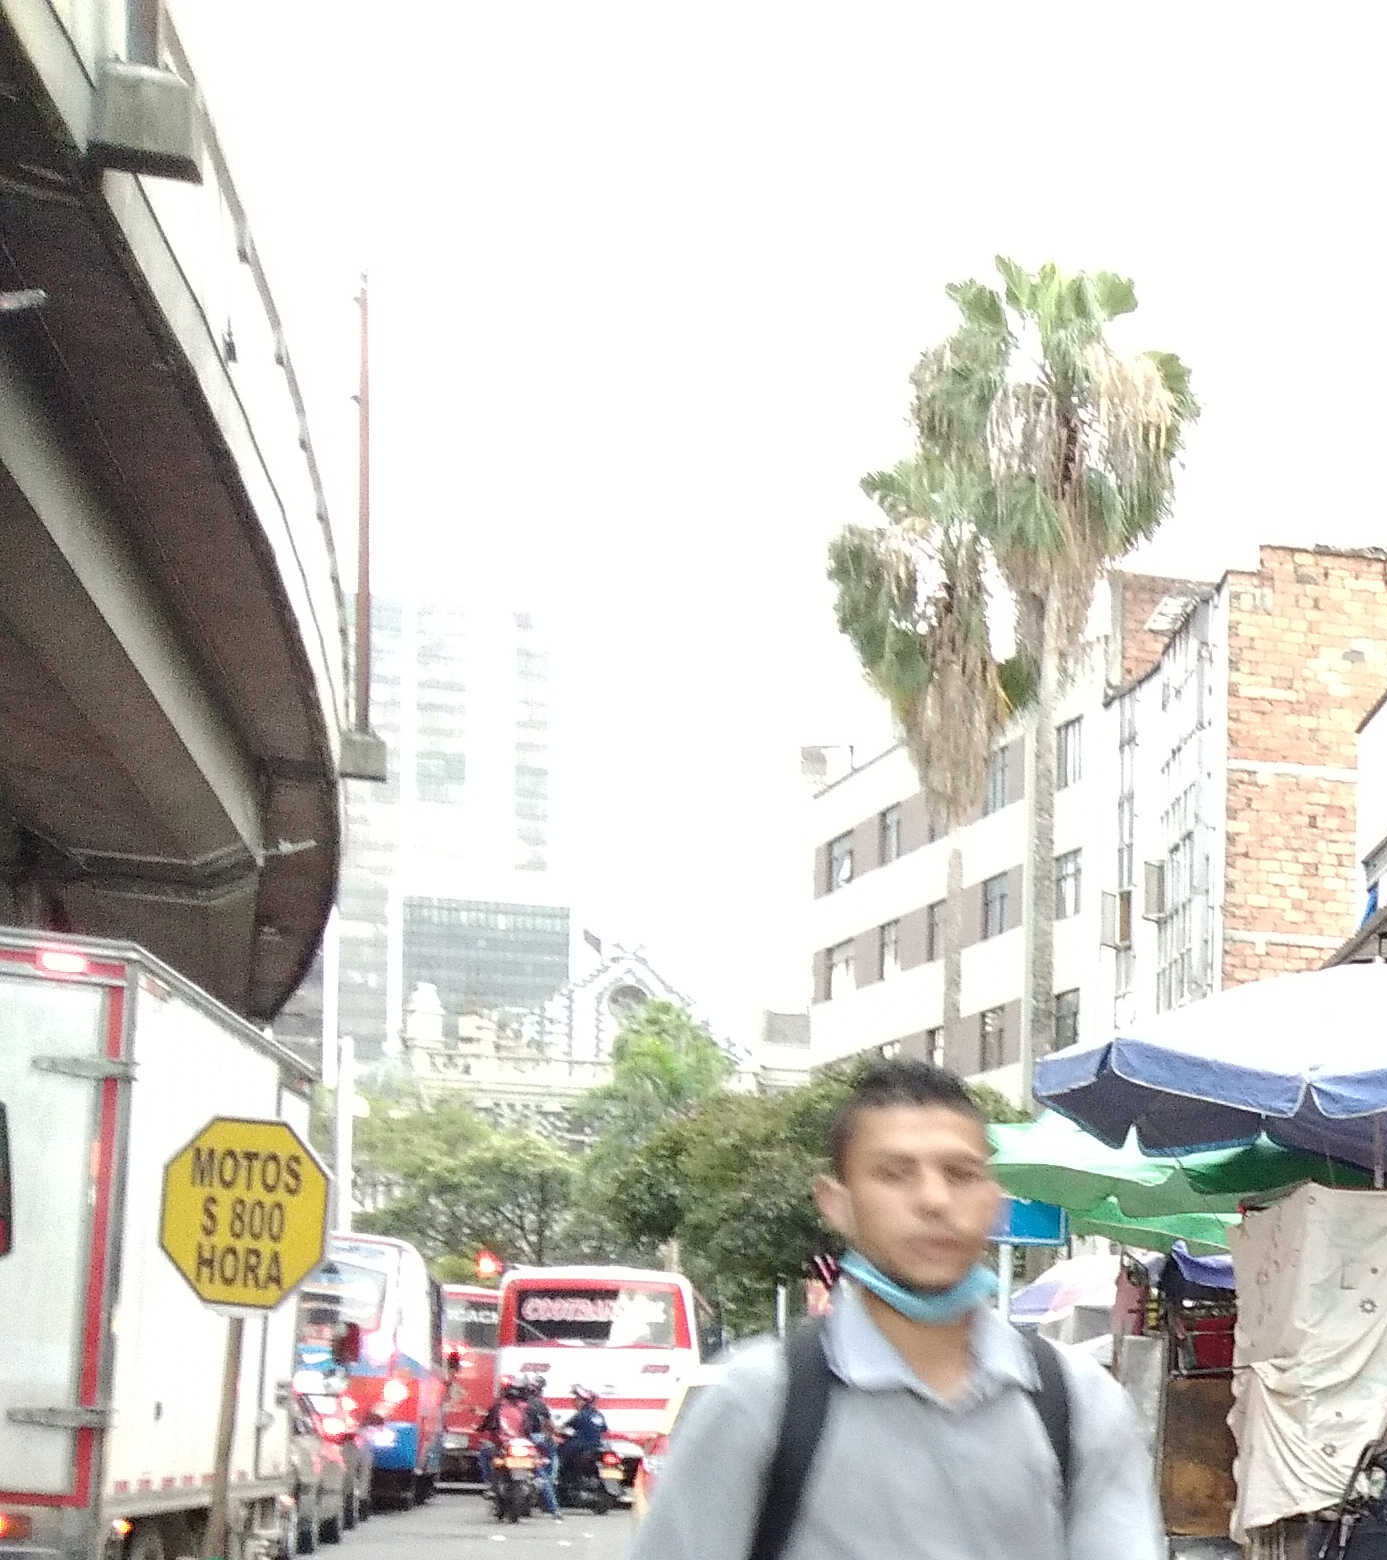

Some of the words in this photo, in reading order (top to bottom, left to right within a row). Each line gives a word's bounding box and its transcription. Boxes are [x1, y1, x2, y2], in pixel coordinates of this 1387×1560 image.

[191, 1147, 303, 1197] MOTOS
[230, 1197, 285, 1244] 800
[195, 1242, 284, 1292] HORA
